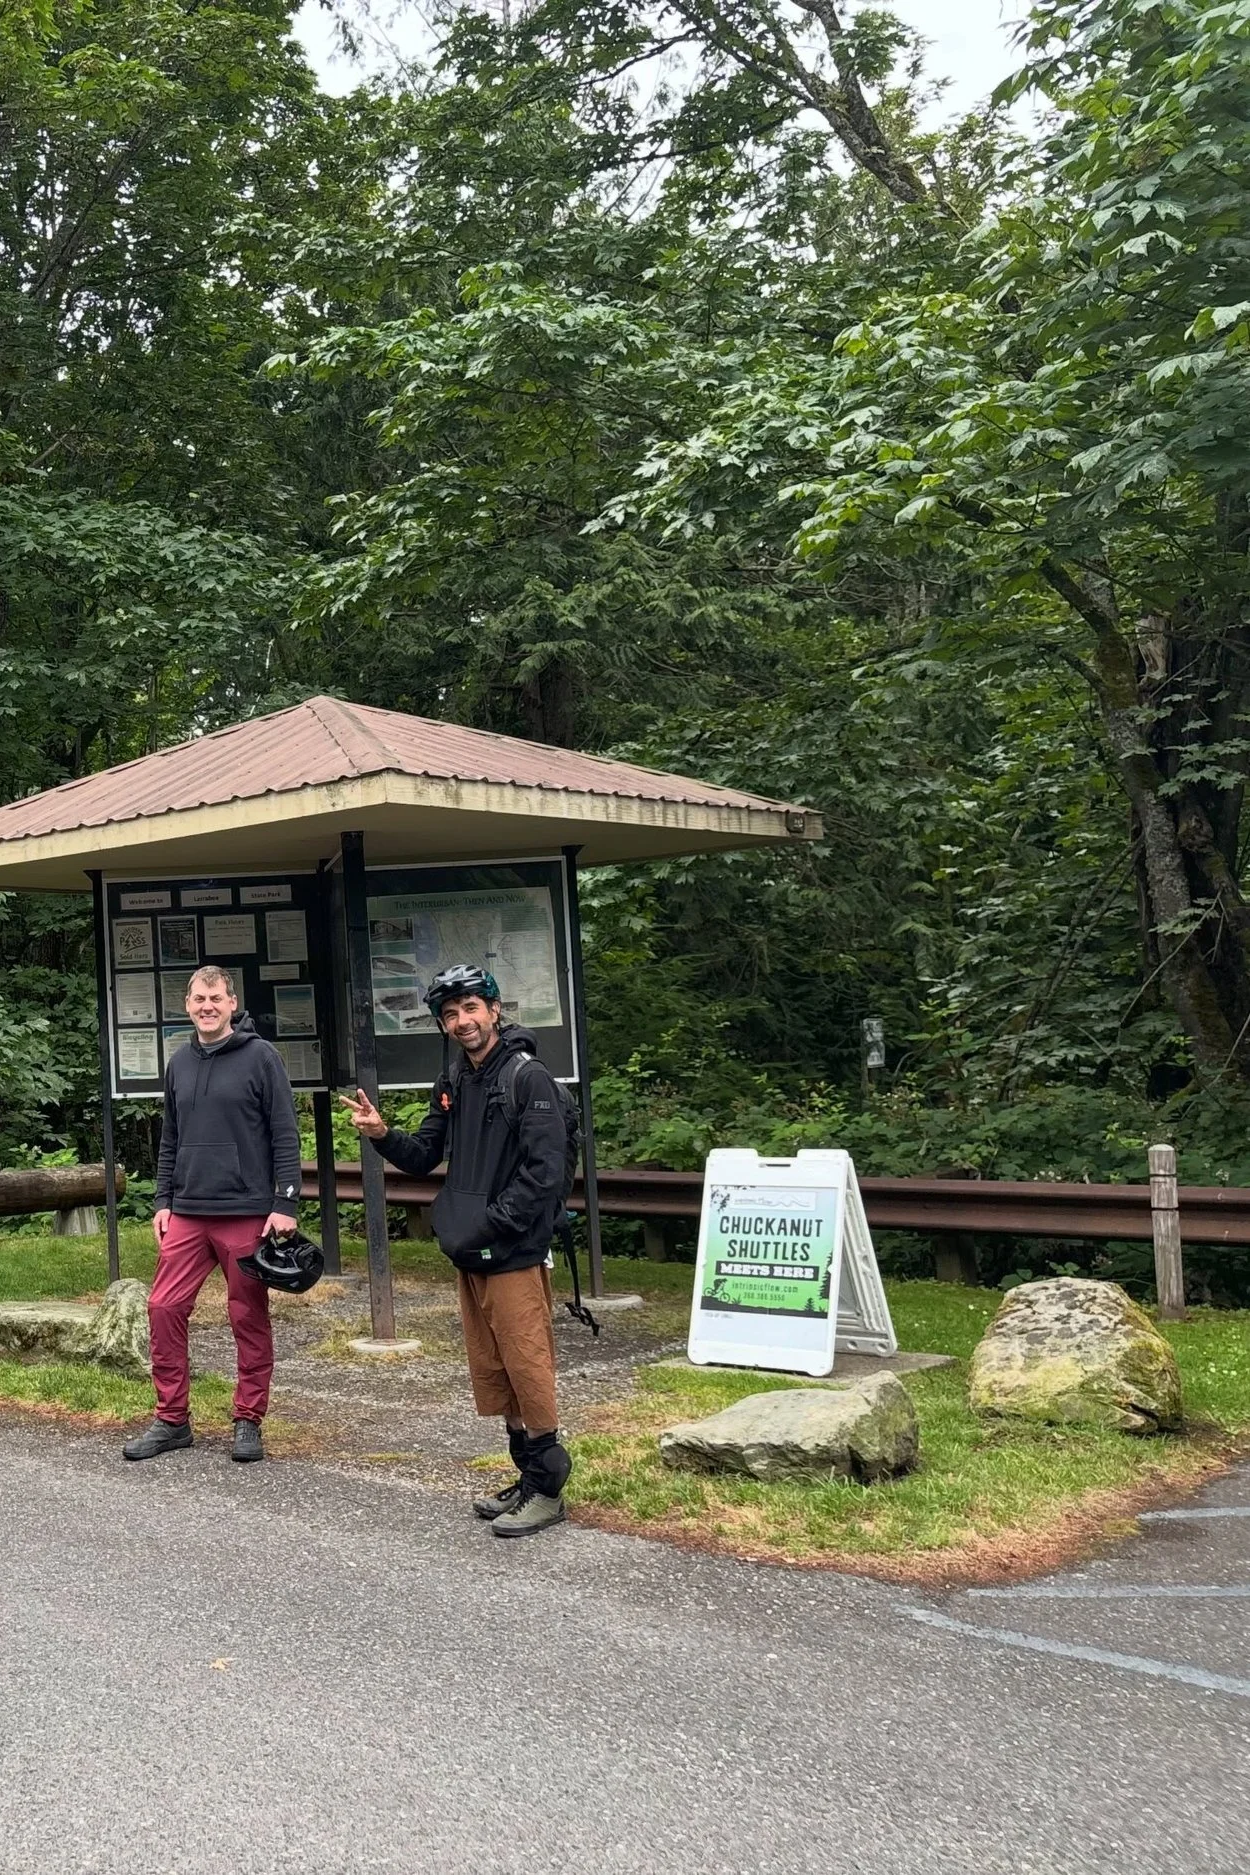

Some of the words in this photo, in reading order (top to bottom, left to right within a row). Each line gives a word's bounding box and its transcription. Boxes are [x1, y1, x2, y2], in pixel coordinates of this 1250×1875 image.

[719, 1215, 824, 1238] CHUCKANUT
[727, 1239, 811, 1261] SHUTTLES
[720, 1262, 770, 1276] MEETS
[772, 1265, 815, 1279] HERE
